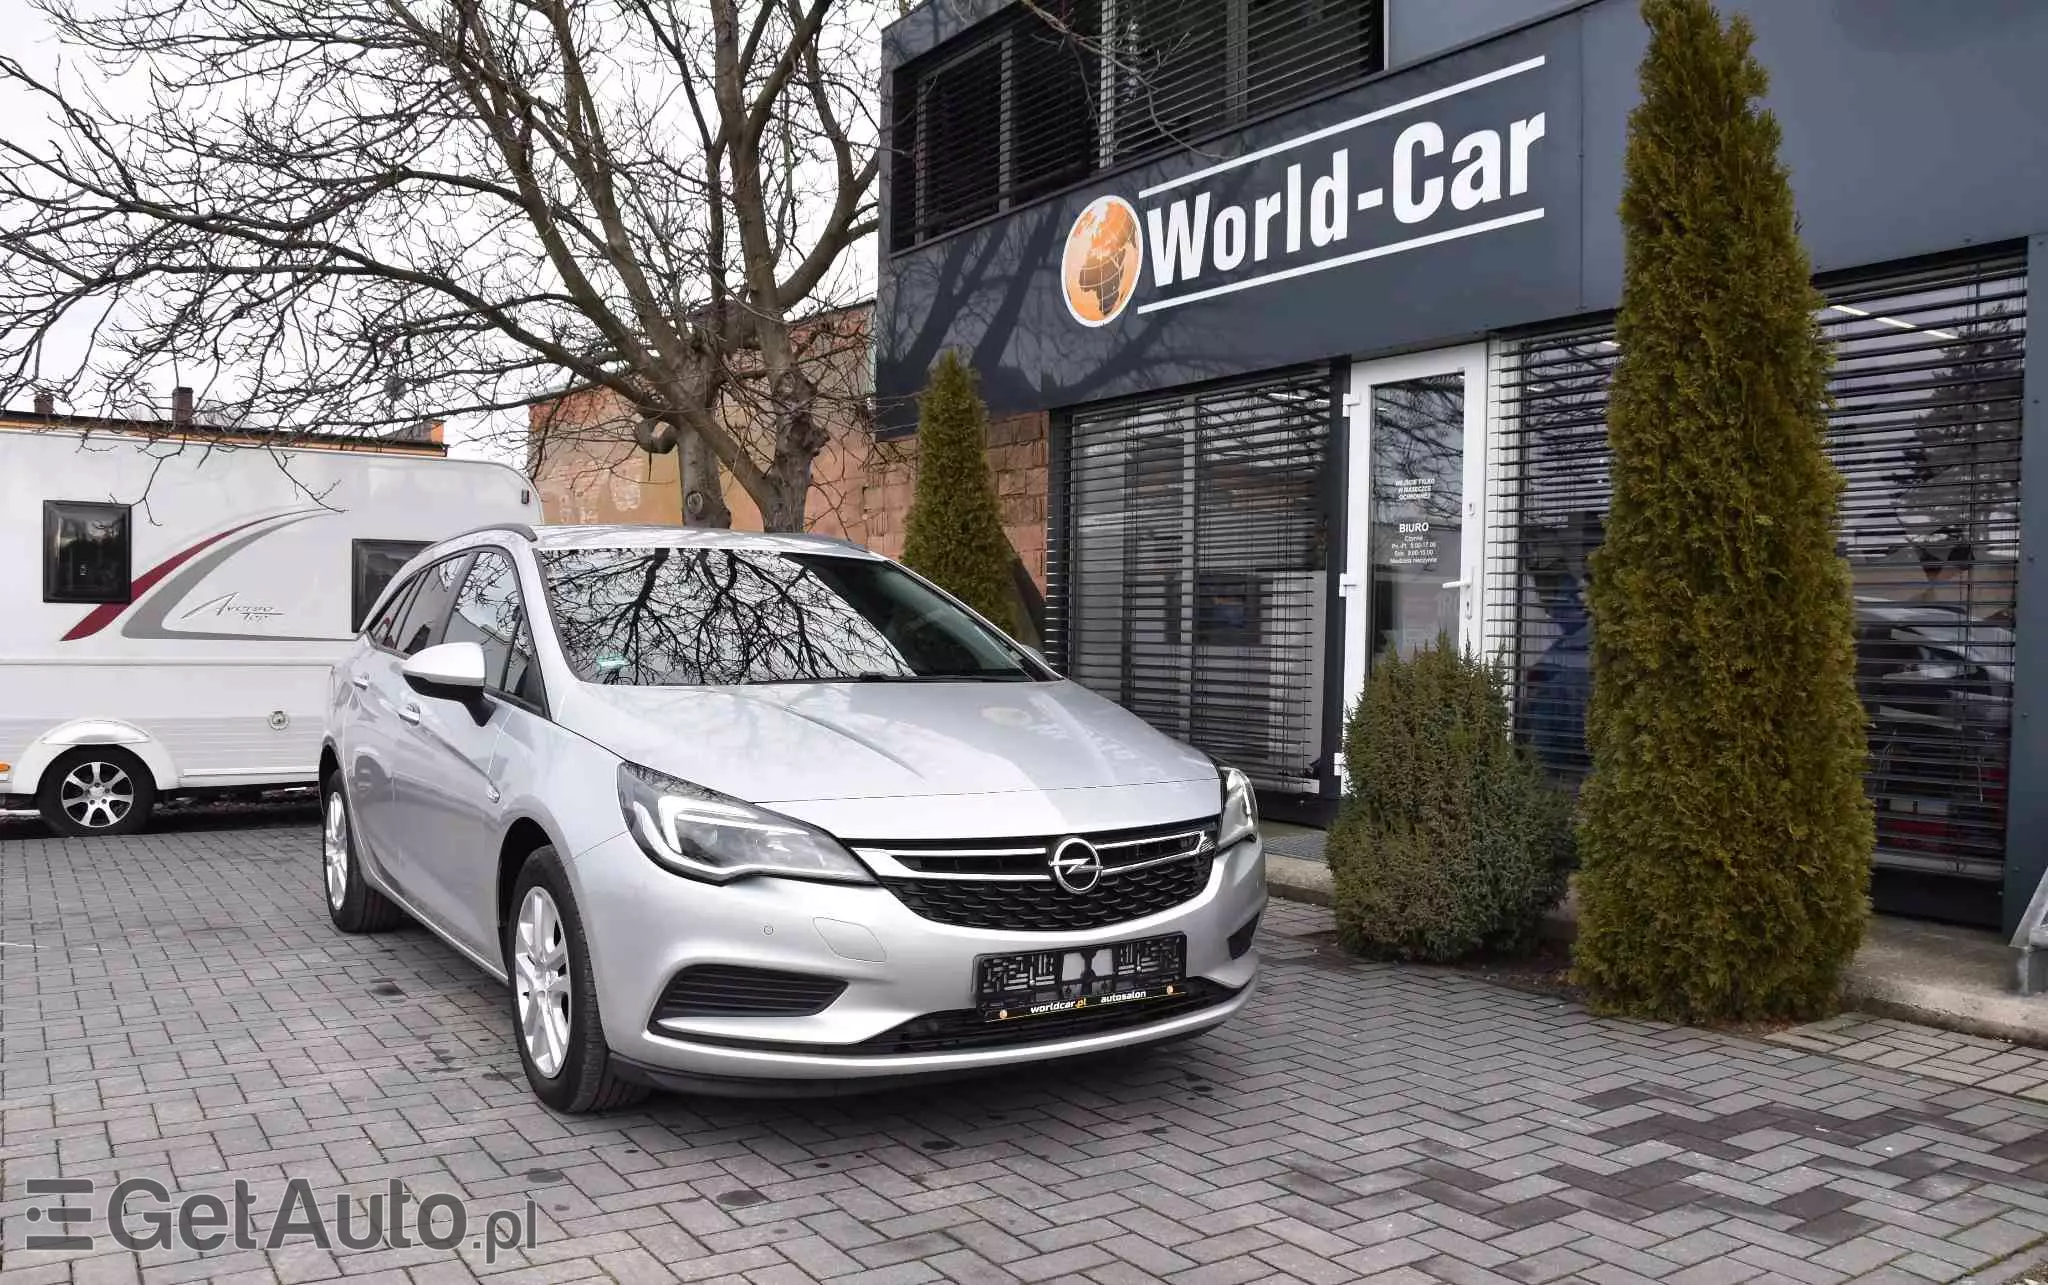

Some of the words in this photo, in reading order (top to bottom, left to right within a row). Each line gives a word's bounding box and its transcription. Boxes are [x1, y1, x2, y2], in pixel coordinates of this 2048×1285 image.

[1146, 111, 1545, 288] World-Car
[1400, 522, 1429, 533] BIURO
[1101, 990, 1146, 1003] autosalon
